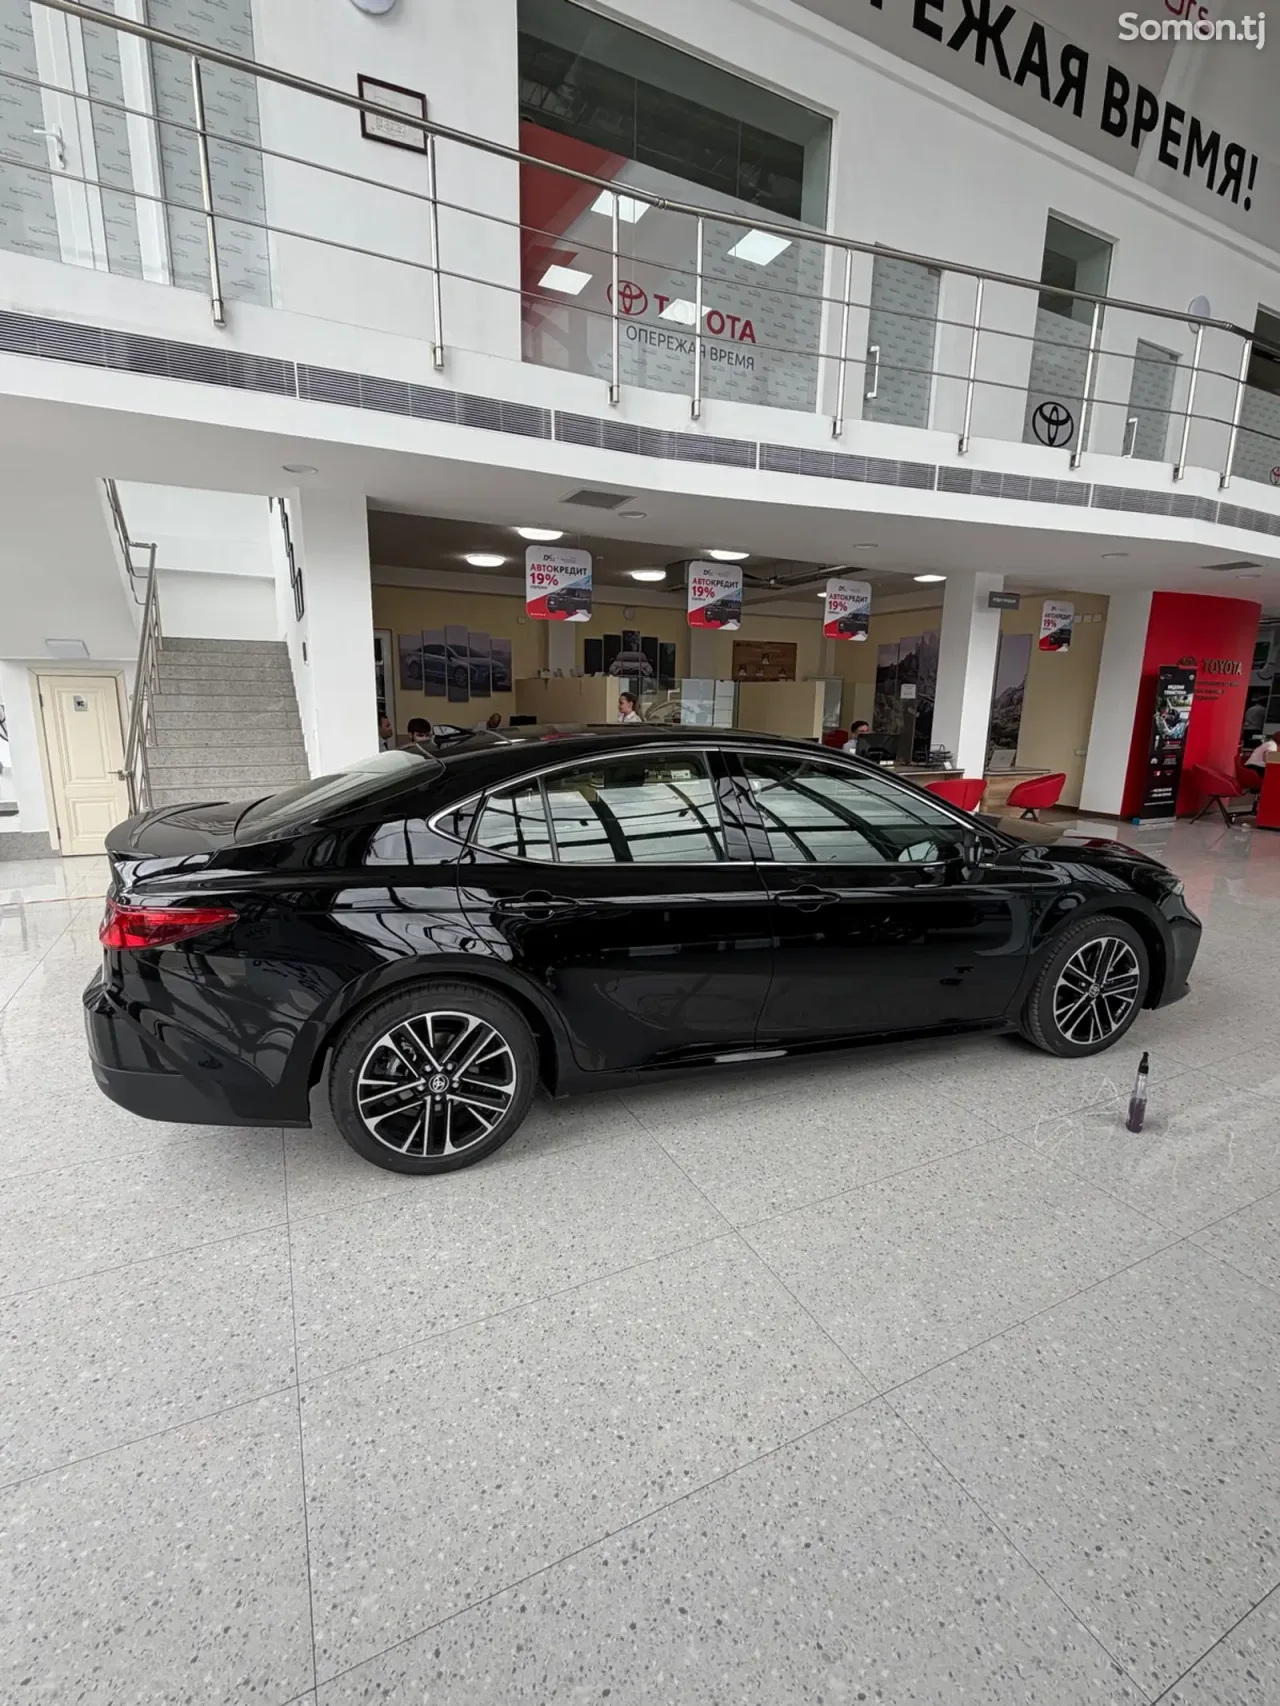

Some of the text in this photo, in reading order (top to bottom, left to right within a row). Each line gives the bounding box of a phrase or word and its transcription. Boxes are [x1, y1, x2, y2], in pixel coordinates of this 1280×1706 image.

[870, 0, 1258, 211] ЕЖАЯ ВРЕМЯ!
[653, 293, 756, 344] TOTA
[710, 346, 755, 371] ВРЕМЯ
[530, 563, 587, 576] АВТОКРЕДИТ
[530, 572, 559, 586] 19%
[692, 577, 739, 589] АВТОКРЕДИТ
[692, 585, 715, 598] 19%
[829, 593, 868, 604] АВТОКРЕДИТ
[828, 600, 848, 612] 19%
[1203, 659, 1242, 676] TOYOTA
